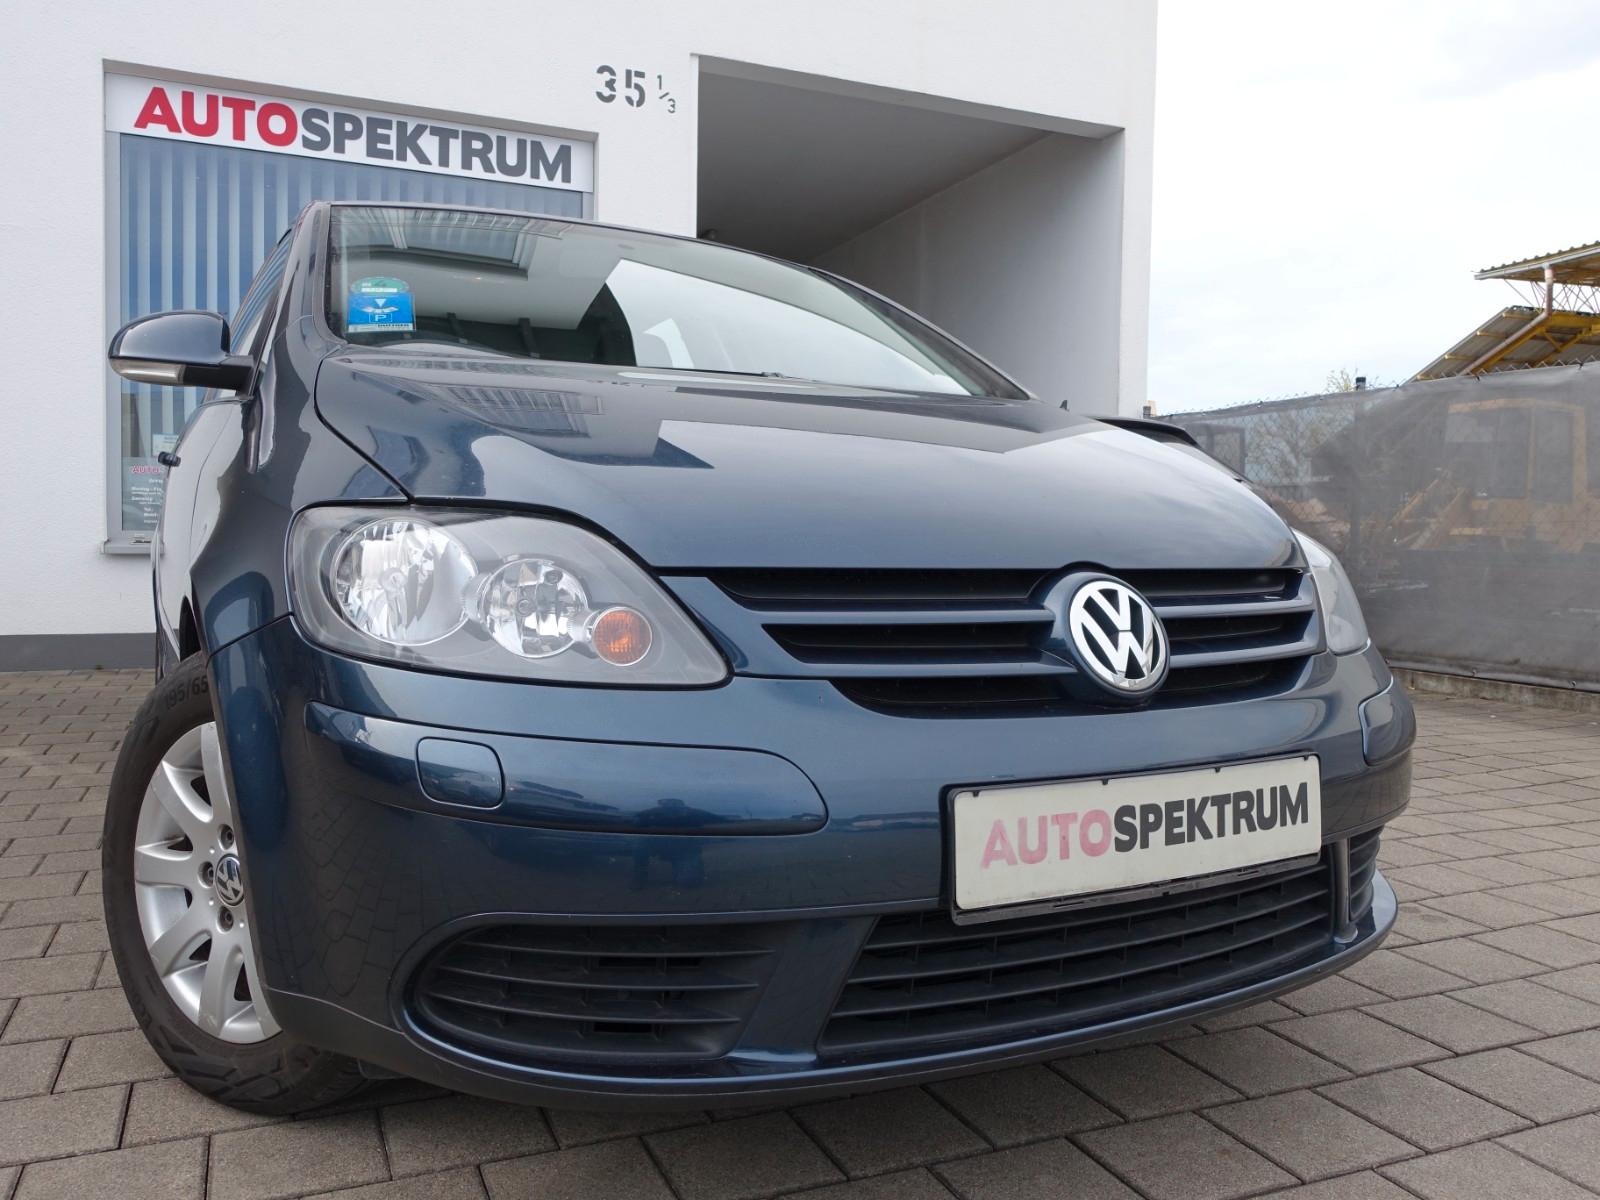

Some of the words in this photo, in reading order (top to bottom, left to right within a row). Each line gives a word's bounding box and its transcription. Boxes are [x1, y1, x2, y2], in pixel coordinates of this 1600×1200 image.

[596, 65, 645, 107] 35
[134, 87, 572, 183] AUTOSPEKTRUM
[1069, 580, 1167, 691] VW
[981, 782, 1309, 869] AUTOSPEKTRUM
